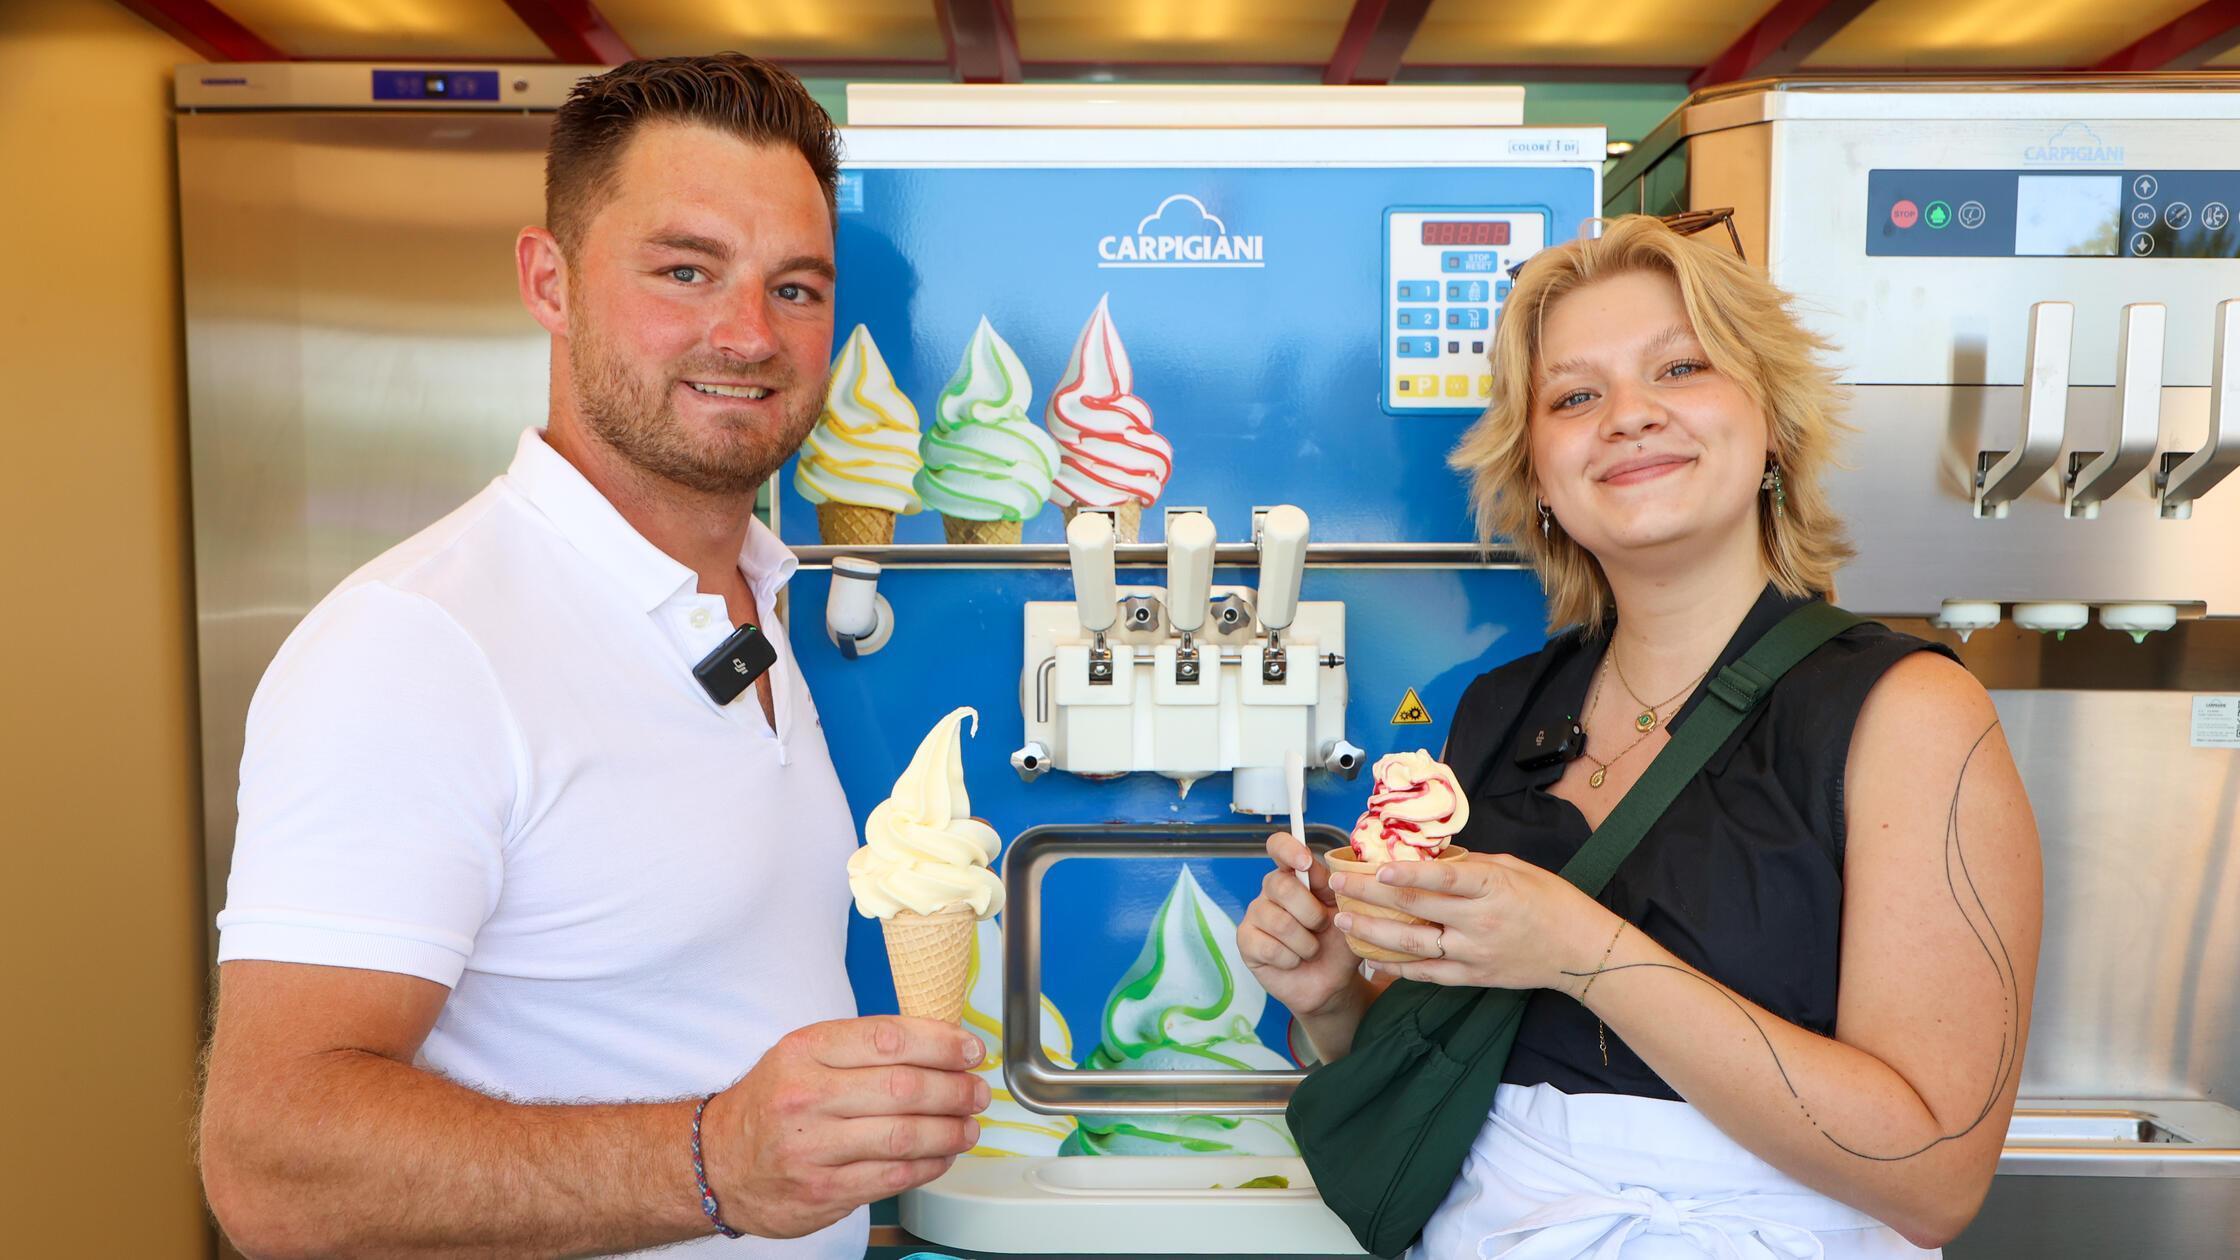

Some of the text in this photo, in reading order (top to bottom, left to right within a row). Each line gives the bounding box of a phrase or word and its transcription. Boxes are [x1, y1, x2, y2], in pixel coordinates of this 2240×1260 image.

[2023, 145, 2125, 161] CARPIGIANI
[1893, 210, 1916, 219] STOP
[2138, 211, 2150, 220] OK
[1098, 235, 1263, 260] CARPIGIANI
[1468, 253, 1490, 262] STOP
[1425, 285, 1431, 297] 1
[1423, 313, 1432, 325] 2
[1423, 341, 1432, 353] 3
[1418, 377, 1432, 395] P
